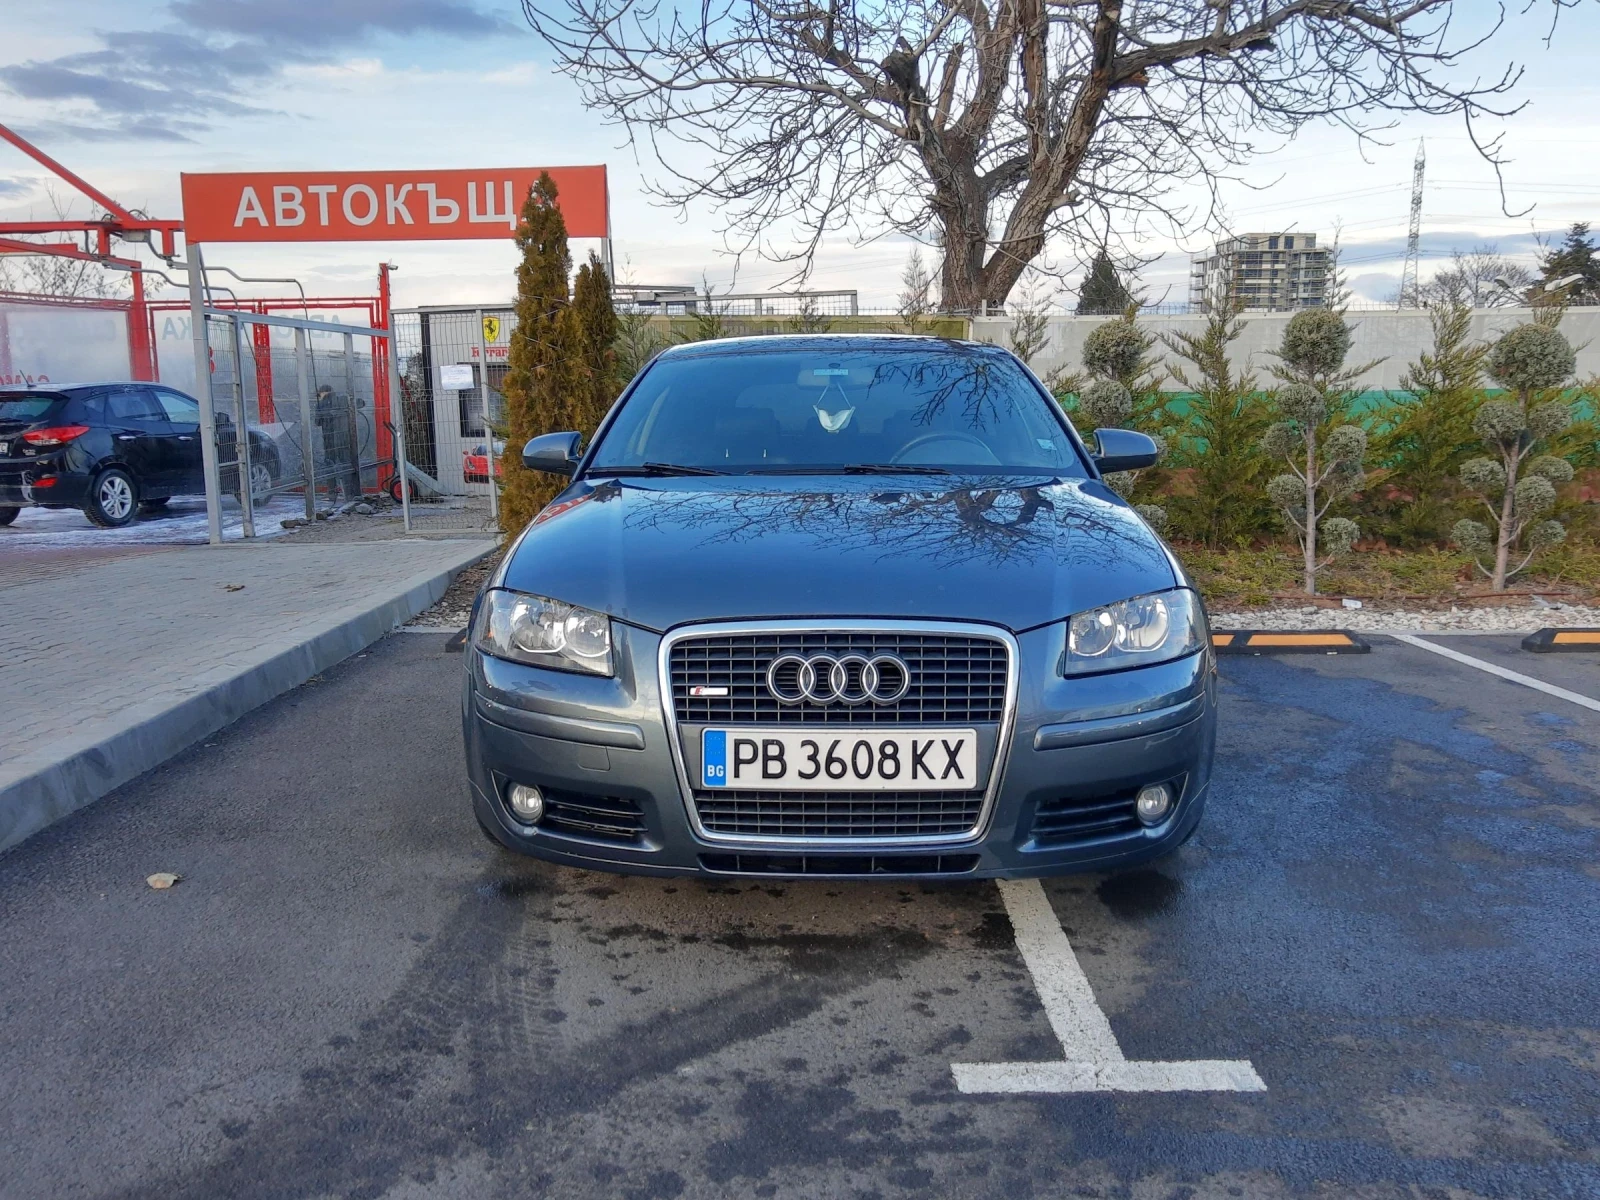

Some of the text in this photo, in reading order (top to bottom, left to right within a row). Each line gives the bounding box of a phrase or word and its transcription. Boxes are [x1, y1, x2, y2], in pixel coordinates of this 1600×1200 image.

[707, 764, 725, 778] BG
[733, 738, 965, 779] PB 3608 KX
